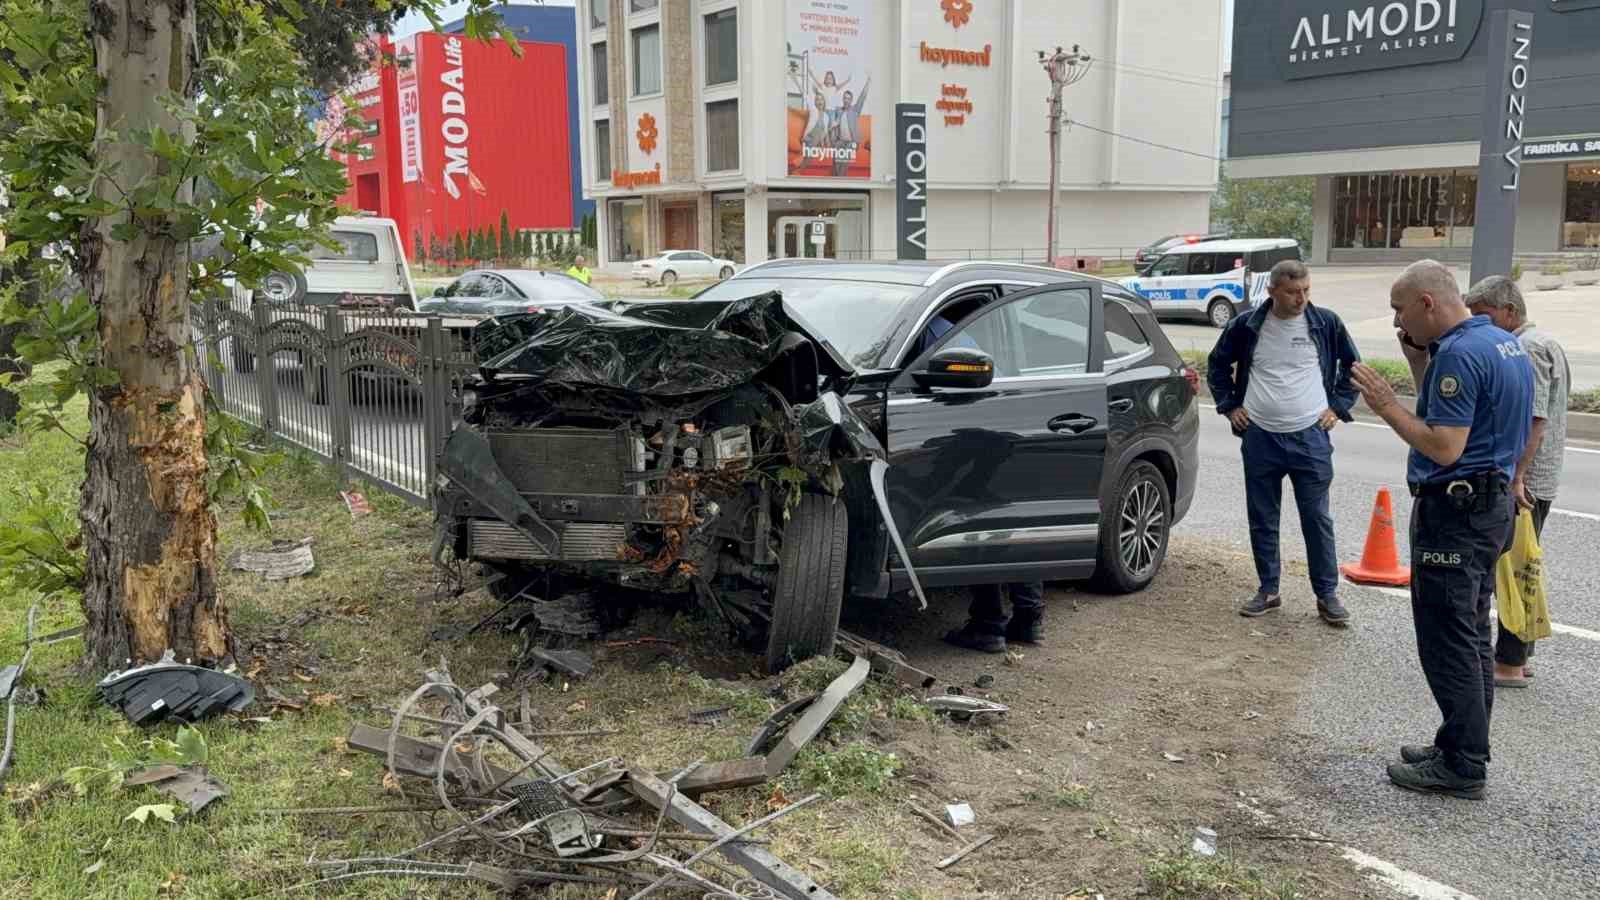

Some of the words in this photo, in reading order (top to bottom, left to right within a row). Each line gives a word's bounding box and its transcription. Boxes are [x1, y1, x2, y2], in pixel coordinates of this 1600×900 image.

[1379, 32, 1455, 52] ALIŞIR
[920, 40, 992, 68] haymoni
[802, 142, 858, 161] haymoni
[1524, 141, 1579, 155] FABRİKA
[613, 162, 661, 190] haymoni
[903, 110, 926, 250] ALMODI
[1149, 290, 1173, 300] POLİS
[1423, 551, 1462, 564] POLİS
